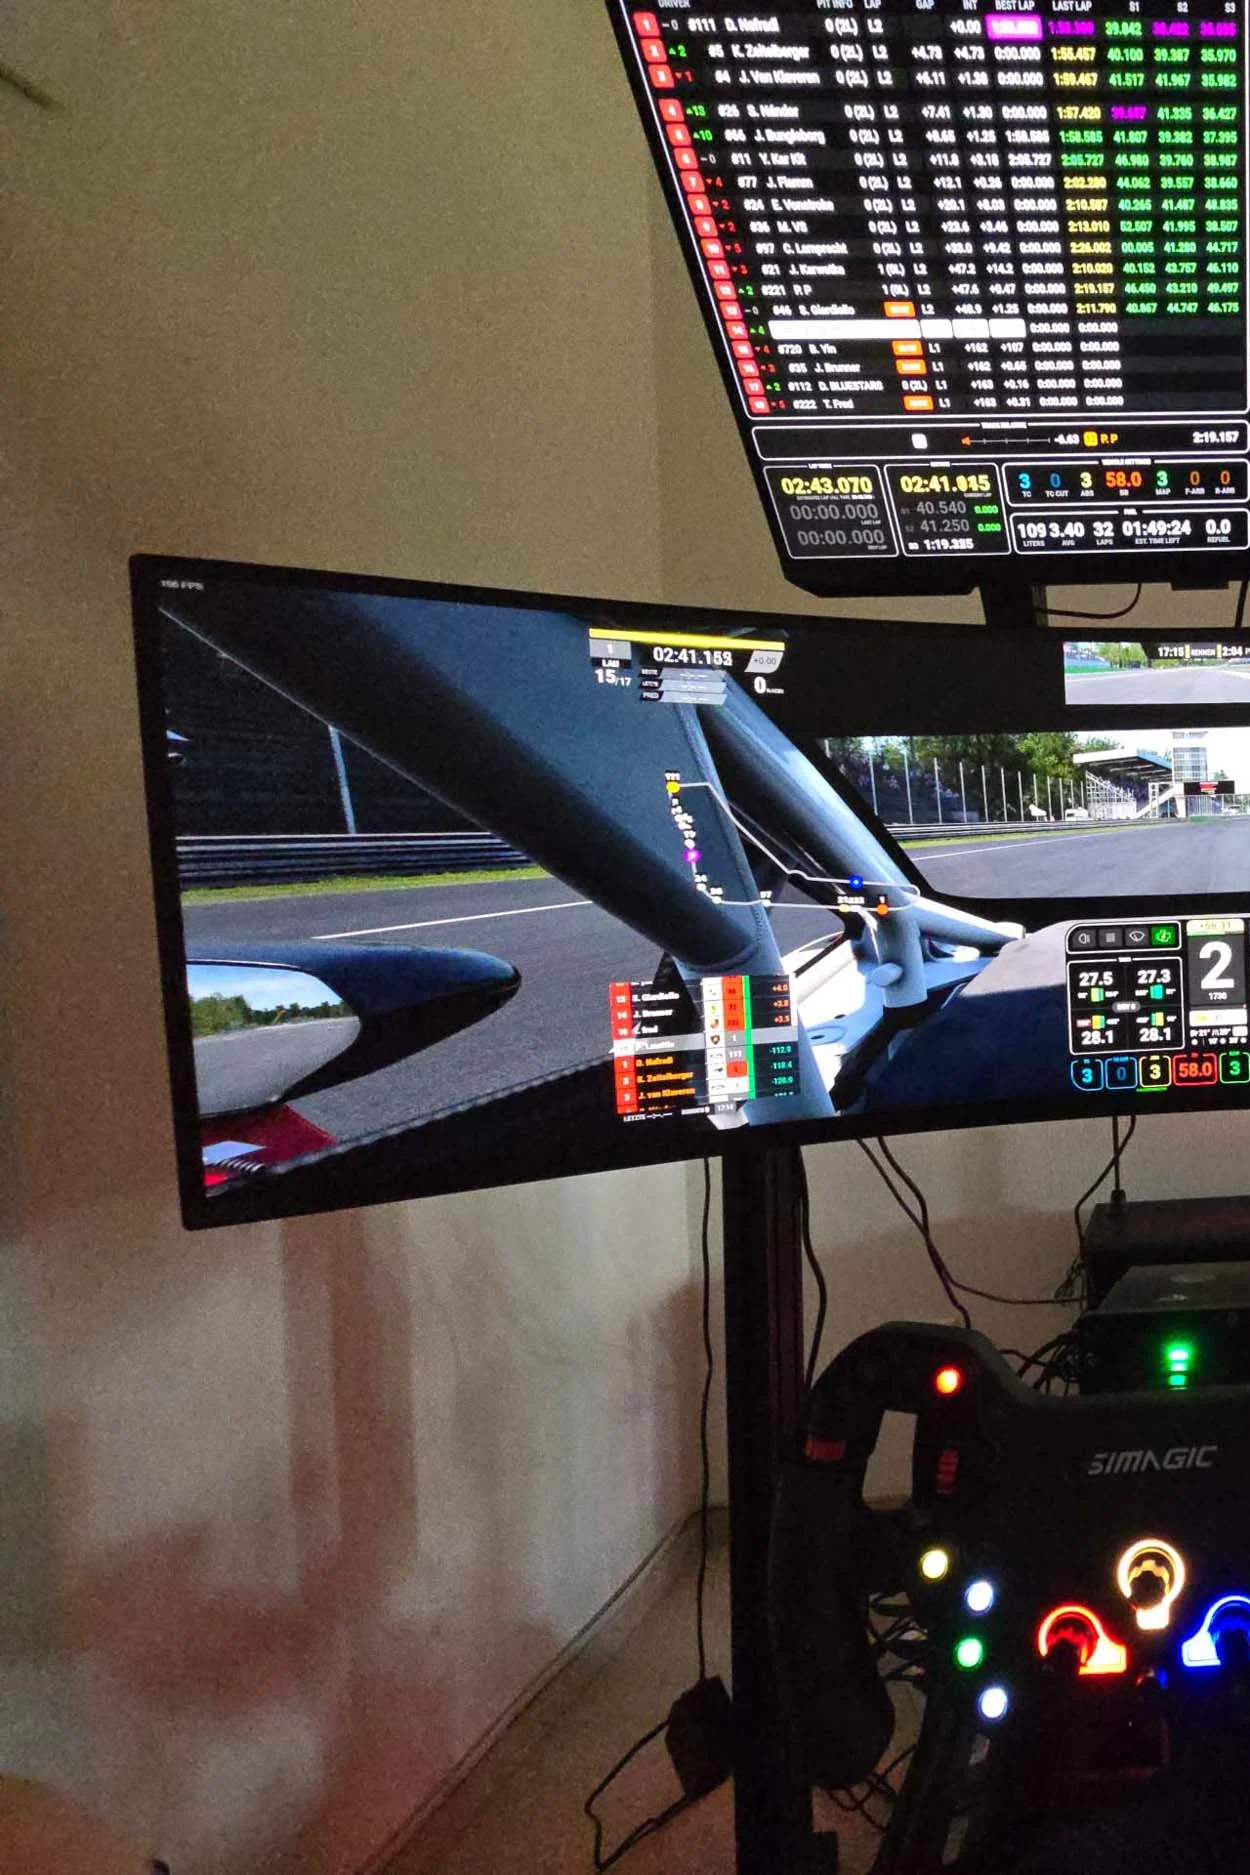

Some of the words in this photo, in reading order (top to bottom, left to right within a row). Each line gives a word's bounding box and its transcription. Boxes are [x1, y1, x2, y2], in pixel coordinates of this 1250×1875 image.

[996, 0, 1016, 10] BEST
[1018, 0, 1035, 10] LAP
[1053, 0, 1074, 11] LAST
[1075, 1, 1092, 11] LAP
[1129, 3, 1139, 12] S1
[1177, 3, 1188, 12] S2
[1225, 3, 1236, 13] S3
[1193, 431, 1239, 443] 2:19.157
[781, 477, 872, 495] 02:43.070
[1019, 473, 1031, 489] 3
[1050, 473, 1061, 488] 0
[1080, 472, 1092, 488] 3
[1105, 472, 1142, 488] 58.0
[1157, 471, 1168, 487] 3
[1190, 471, 1200, 485] 0
[1220, 470, 1230, 485] 0
[790, 504, 878, 520] 00:00.000
[916, 501, 966, 514] 40.540
[920, 520, 969, 532] 41.250
[1017, 523, 1047, 538] 109
[1049, 522, 1085, 538] 3.40
[1093, 521, 1114, 537] 32
[1122, 520, 1191, 536] 01:49:24
[1206, 519, 1231, 535] 0.0
[798, 530, 884, 545] 00:00.000
[606, 644, 613, 654] 1
[1158, 647, 1184, 657] 17:15
[754, 677, 766, 693] 0
[1199, 940, 1235, 989] 2
[1079, 972, 1113, 987] 27.5
[1137, 969, 1171, 984] 27.3
[1208, 992, 1227, 1000] 1730
[1081, 1031, 1113, 1045] 28.1
[1139, 1028, 1171, 1042] 28.1
[1082, 1068, 1093, 1084] 3
[1117, 1066, 1126, 1080] 0
[1150, 1064, 1161, 1079] 3
[1179, 1062, 1212, 1077] 58.0
[1229, 1061, 1240, 1075] 3
